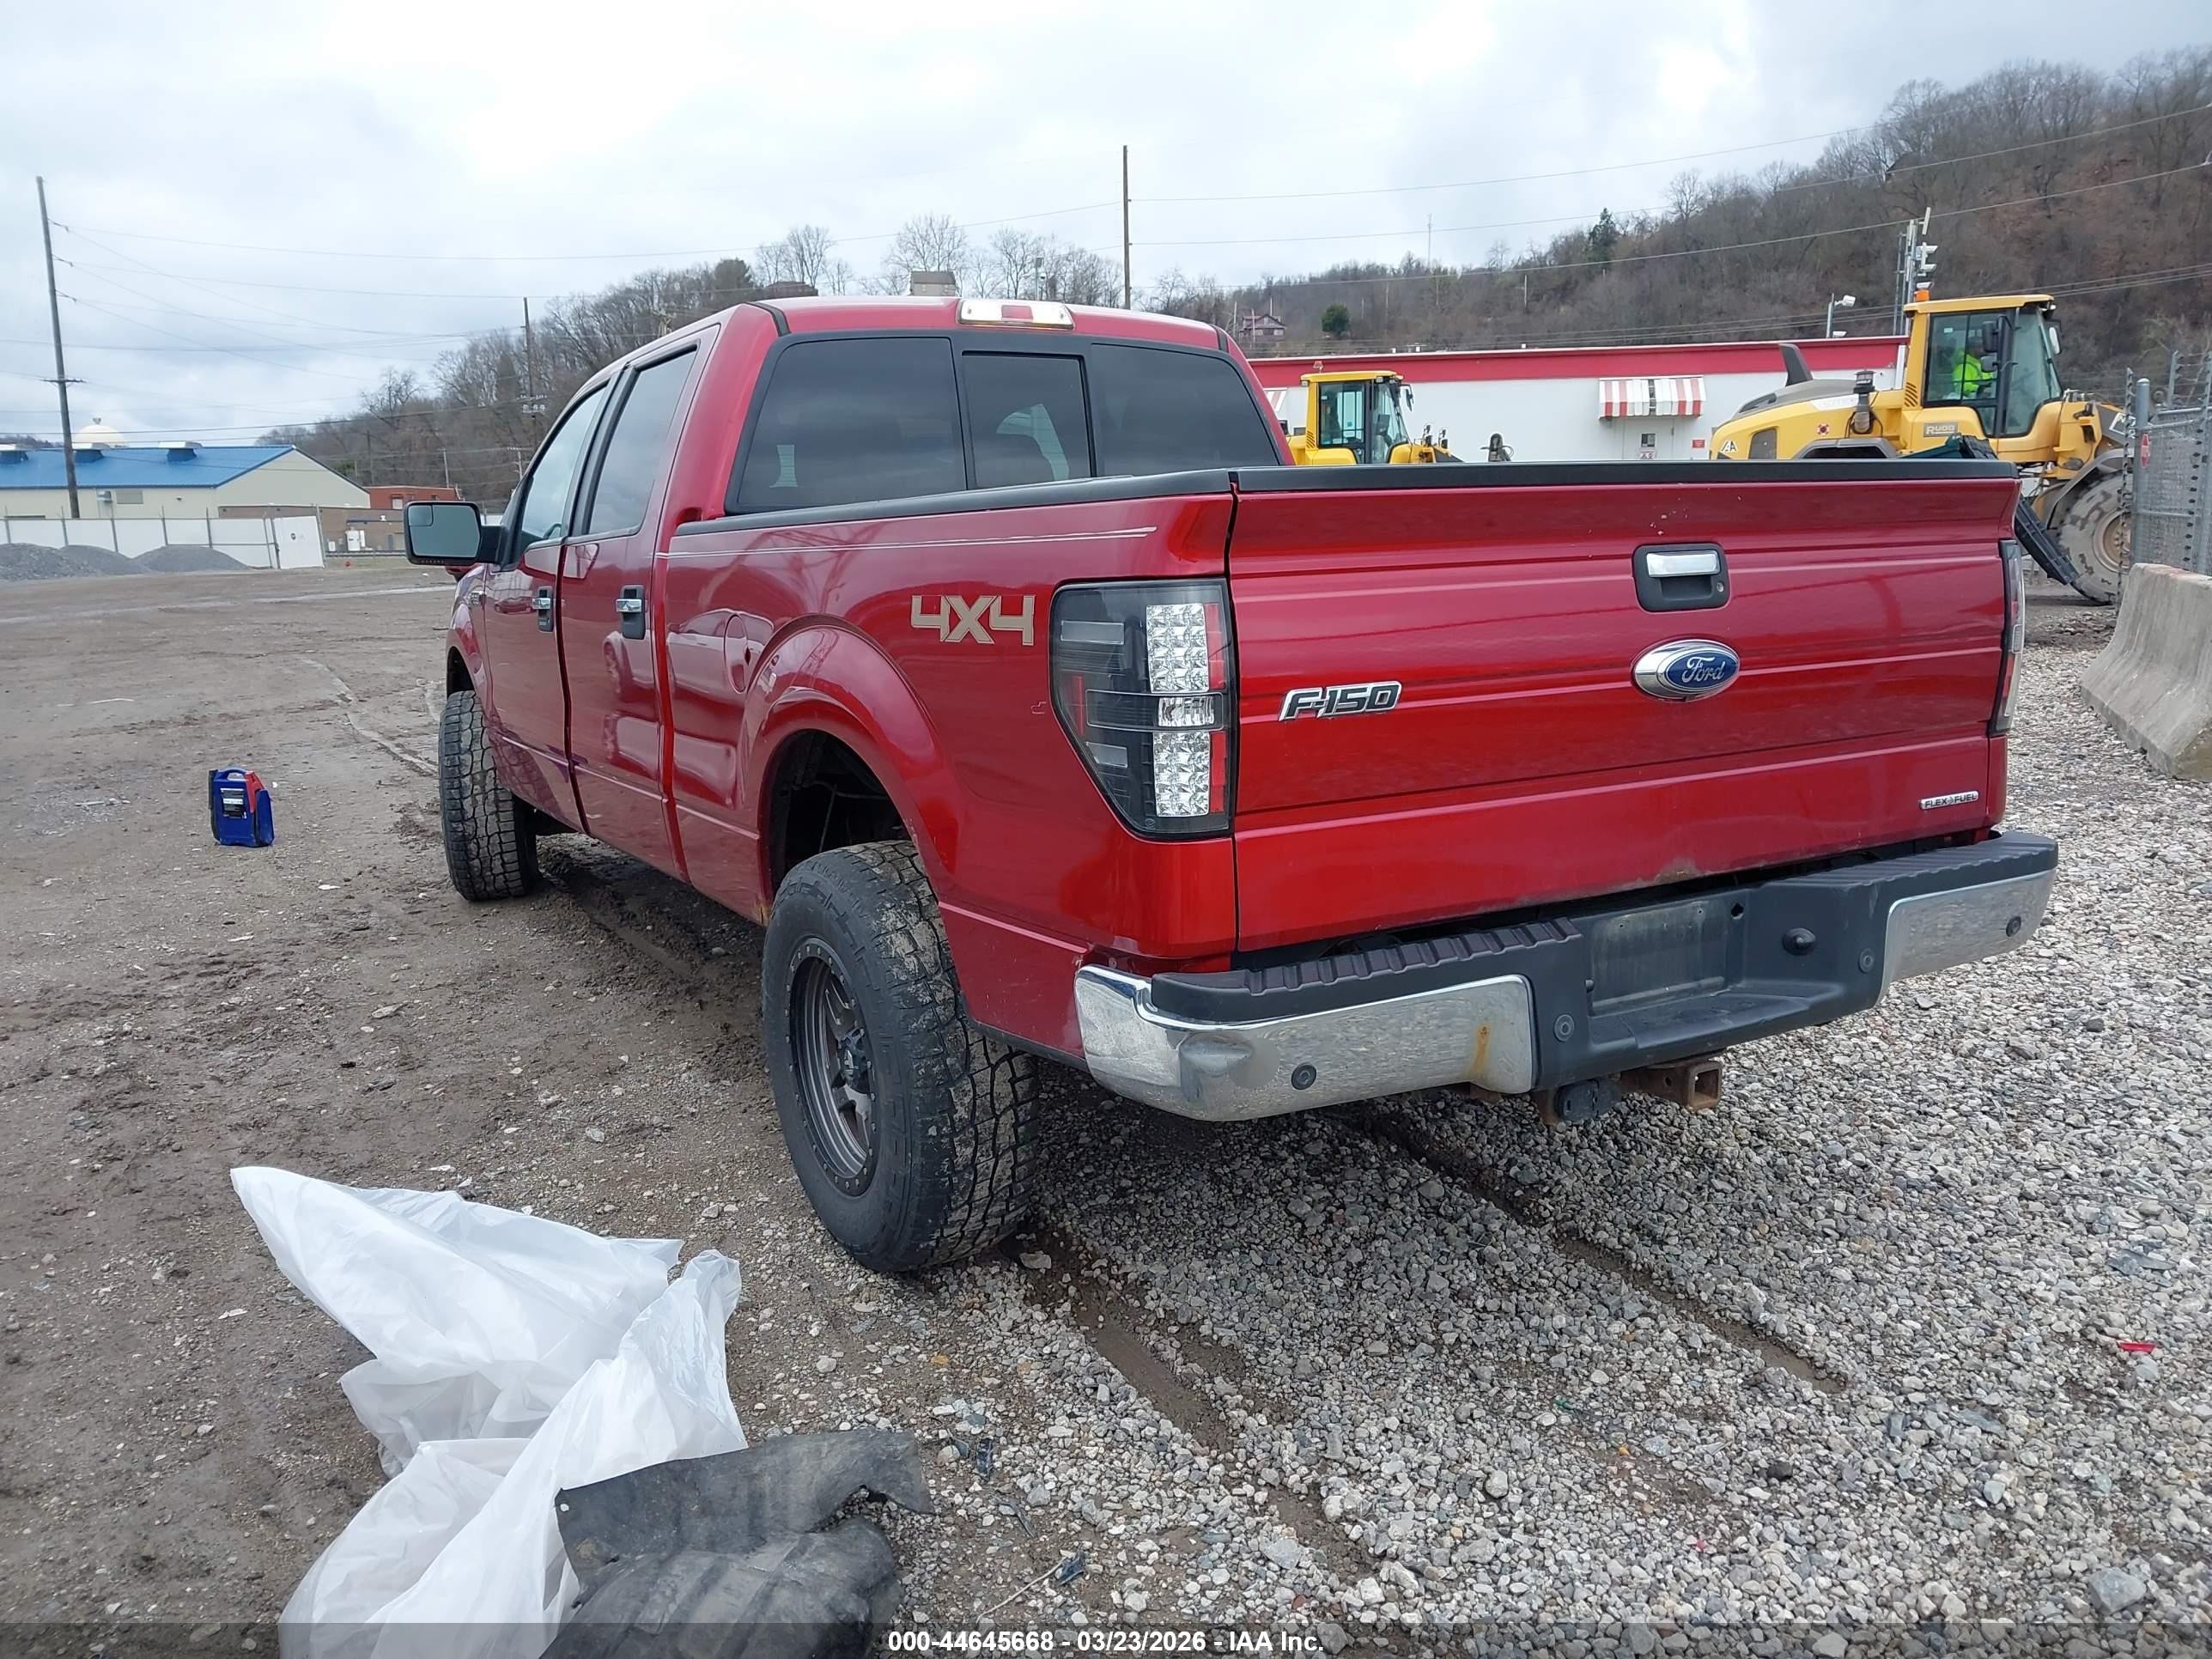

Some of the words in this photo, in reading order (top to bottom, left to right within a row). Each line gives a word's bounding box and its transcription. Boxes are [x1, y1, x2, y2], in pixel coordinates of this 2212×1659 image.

[1681, 656, 1726, 684] Ford
[1279, 680, 1402, 721] F-150
[1923, 797, 1948, 808] FLEX
[1954, 793, 1978, 804] FUEL
